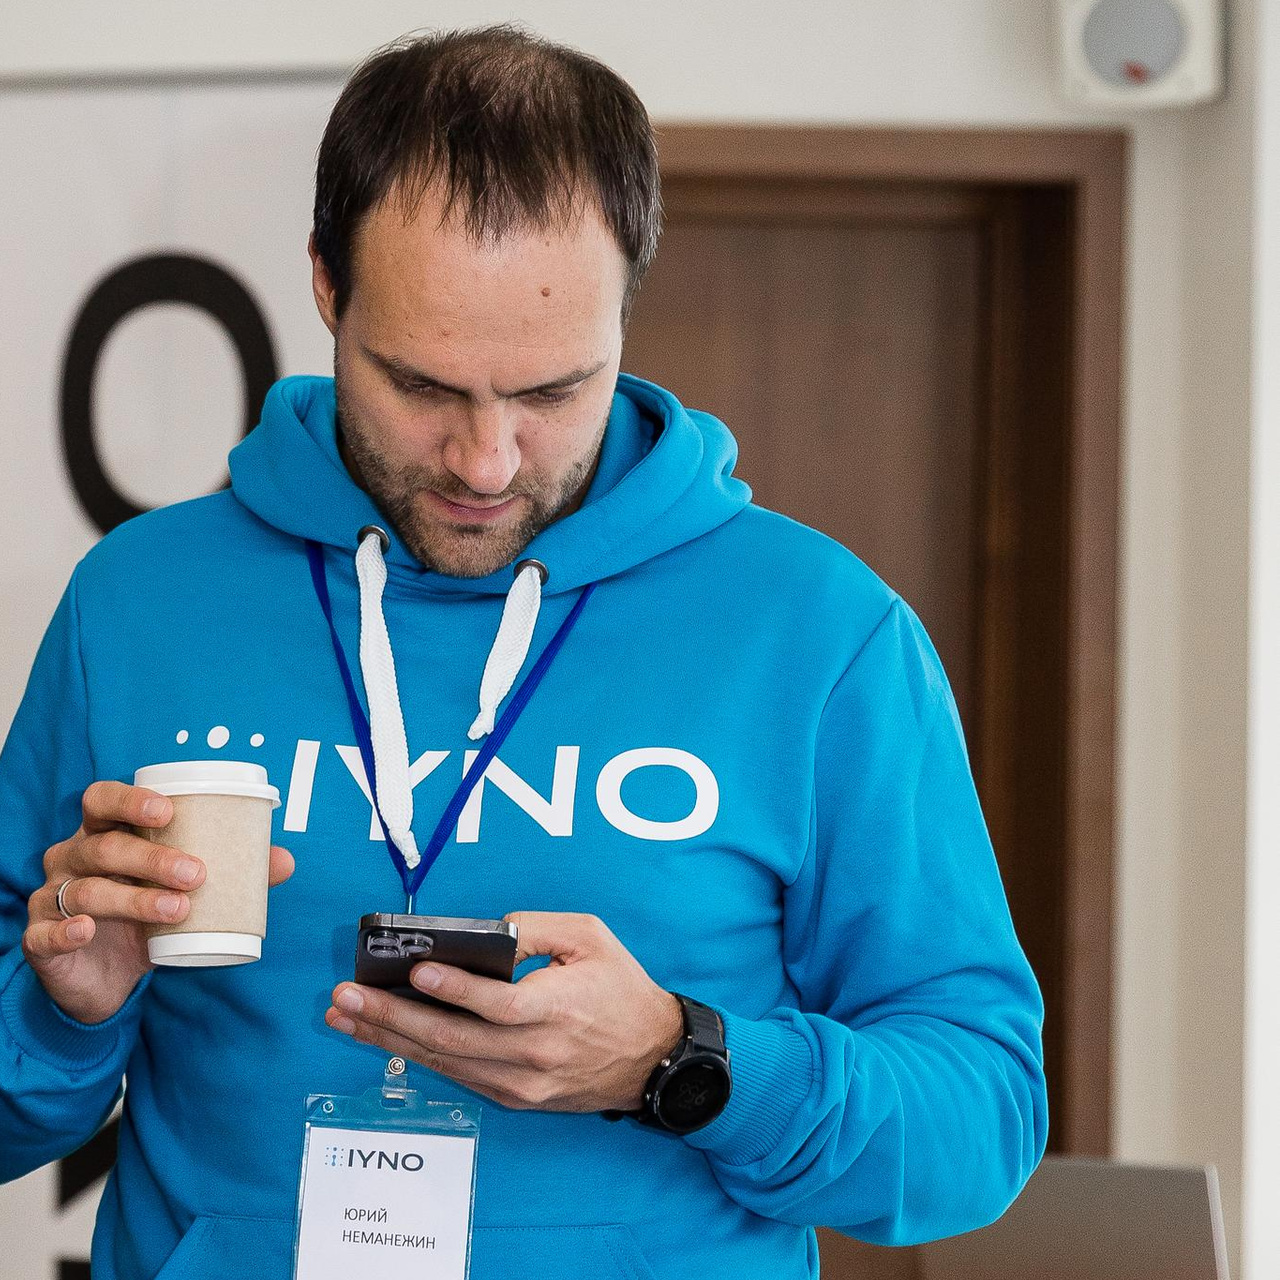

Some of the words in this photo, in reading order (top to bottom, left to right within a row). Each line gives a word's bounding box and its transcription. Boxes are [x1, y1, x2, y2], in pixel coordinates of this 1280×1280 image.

[282, 738, 721, 844] IYNO
[347, 1148, 424, 1172] IYNO
[344, 1207, 388, 1224] ЮРИЙ
[342, 1229, 436, 1250] НЕМАНЕЖИН
